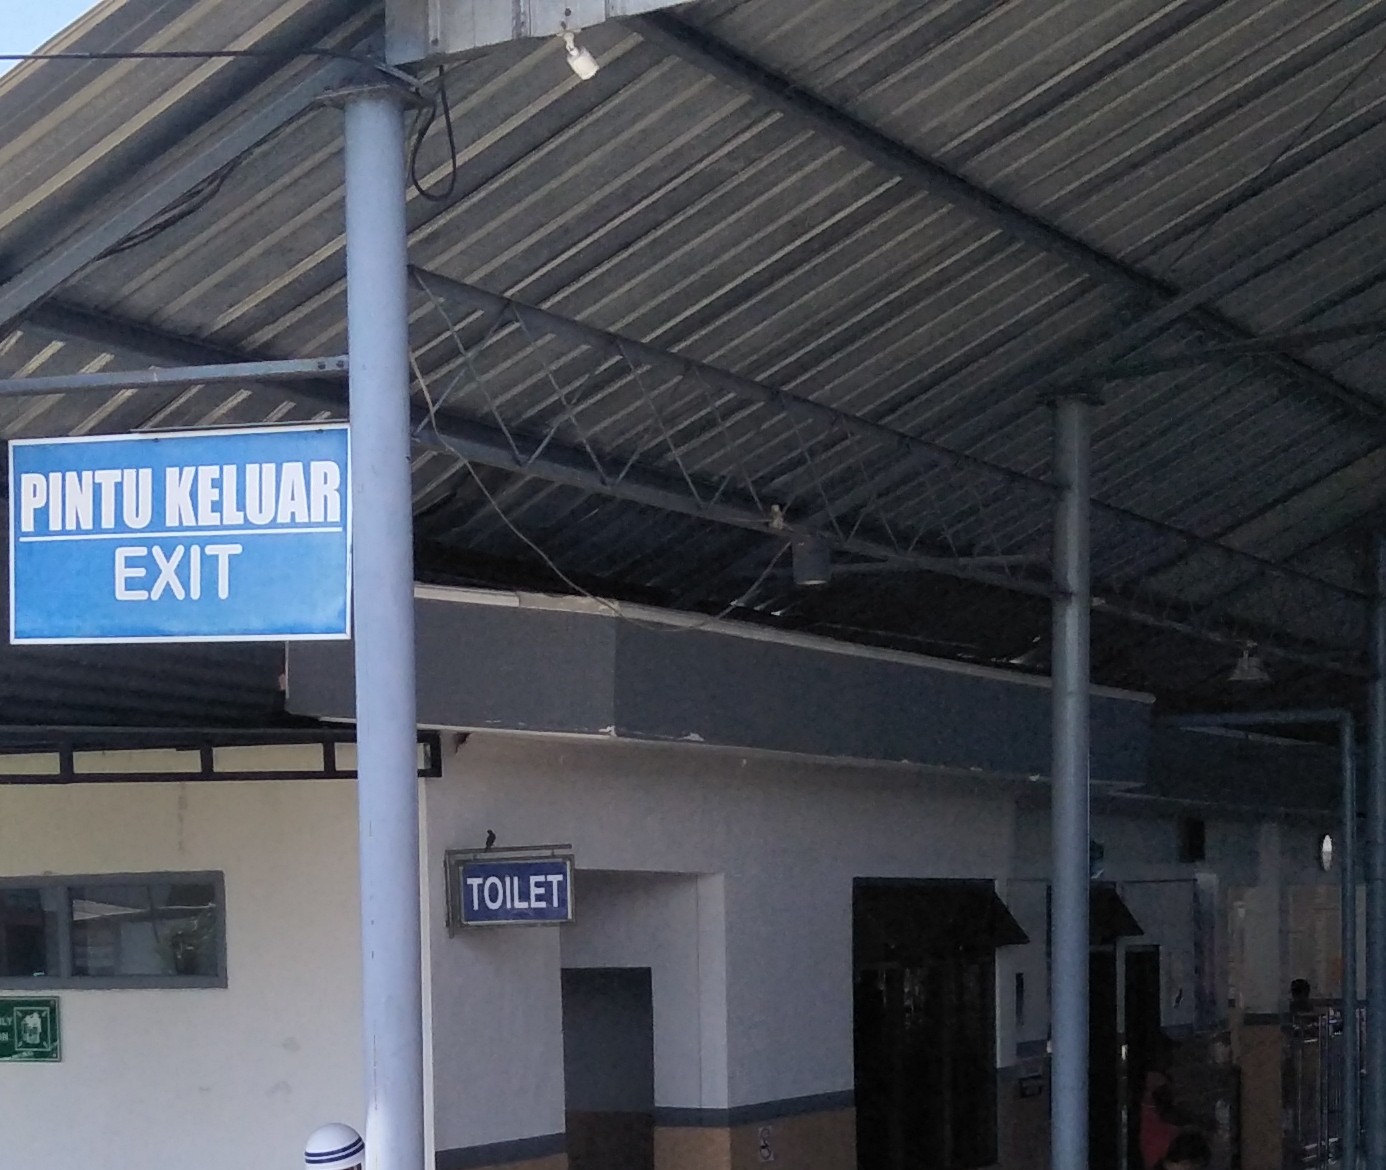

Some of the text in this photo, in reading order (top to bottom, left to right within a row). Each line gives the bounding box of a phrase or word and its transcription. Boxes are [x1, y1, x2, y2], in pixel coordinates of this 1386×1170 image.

[19, 460, 341, 532] PINTU KELUAR
[114, 543, 243, 601] EXIT
[466, 874, 564, 911] TOILET
